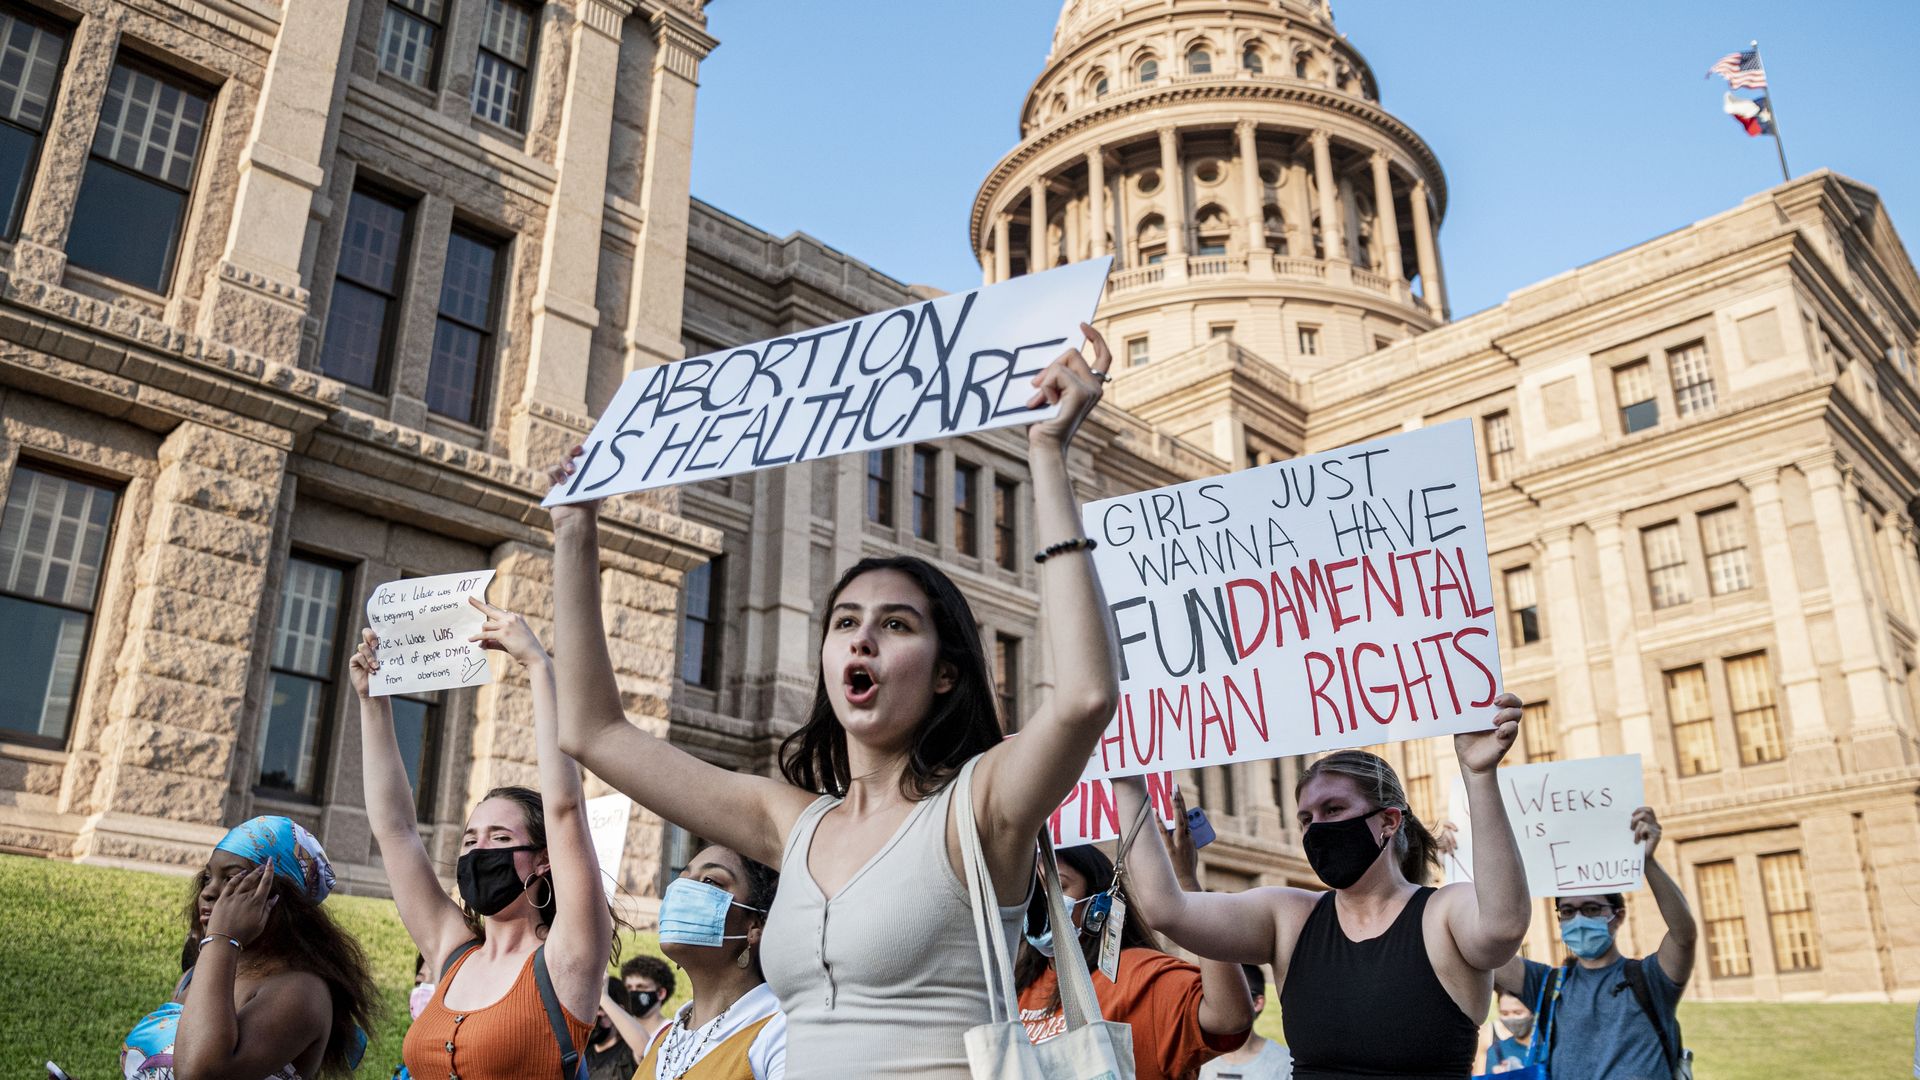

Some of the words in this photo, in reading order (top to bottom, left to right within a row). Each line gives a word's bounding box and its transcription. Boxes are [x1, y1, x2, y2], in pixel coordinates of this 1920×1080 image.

[617, 291, 978, 432] ABORTION
[566, 429, 644, 496] IS
[642, 337, 1067, 481] HEALTHCARE
[1103, 484, 1230, 547] GIRLS
[1272, 448, 1389, 508] JUST
[1128, 518, 1299, 586] WANNA
[1329, 483, 1467, 556] HAVE
[383, 610, 414, 624] beginning
[418, 606, 427, 615] of
[433, 628, 454, 642] WAS
[1109, 547, 1494, 681] FUNDAMENTAL
[385, 675, 402, 686] from
[417, 668, 451, 680] abortions
[389, 655, 405, 666] end
[411, 651, 420, 664] of
[1101, 667, 1269, 772] HUMAN
[1304, 627, 1497, 737] RIGHTS
[1511, 773, 1613, 815] WEEKS
[1525, 822, 1546, 838] IS
[1549, 841, 1642, 887] ENOUGH
